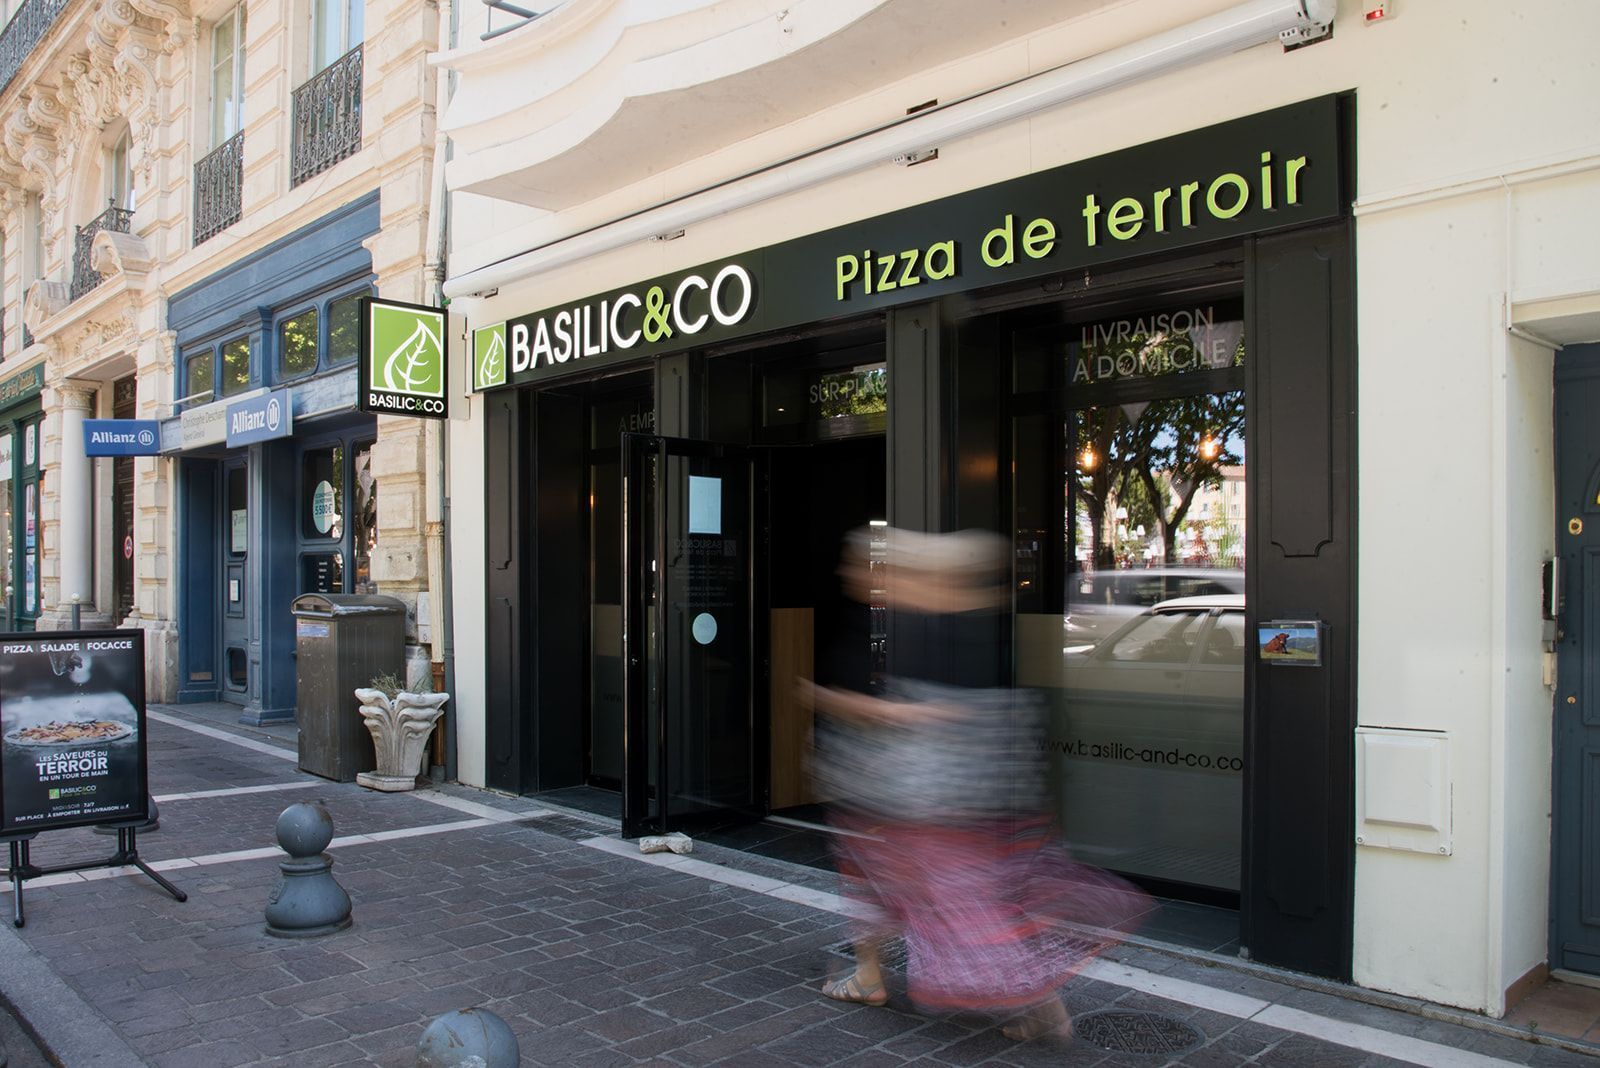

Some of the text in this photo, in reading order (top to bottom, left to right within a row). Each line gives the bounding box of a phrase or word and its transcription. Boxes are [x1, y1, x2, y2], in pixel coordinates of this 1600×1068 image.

[837, 151, 1306, 300] Pizza de terroir
[511, 264, 752, 374] BASILIC&CO
[1082, 306, 1214, 349] LIVRAISON
[1098, 338, 1226, 379] DOMICILE
[809, 374, 887, 404] SUR PLAC
[369, 393, 444, 413] BASILIC&CO
[232, 409, 266, 435] Allianz
[629, 412, 655, 433] EMP
[91, 431, 136, 444] Allianz
[3, 641, 133, 654] PIZZA SALADE FOCACCE
[35, 757, 108, 775] TERROIR
[53, 750, 96, 761] SAVEURS
[1036, 739, 1243, 772] ww.basilic-and-co.co
[61, 785, 96, 794] BASILIC&CO
[92, 805, 119, 813] LIVRAISON
